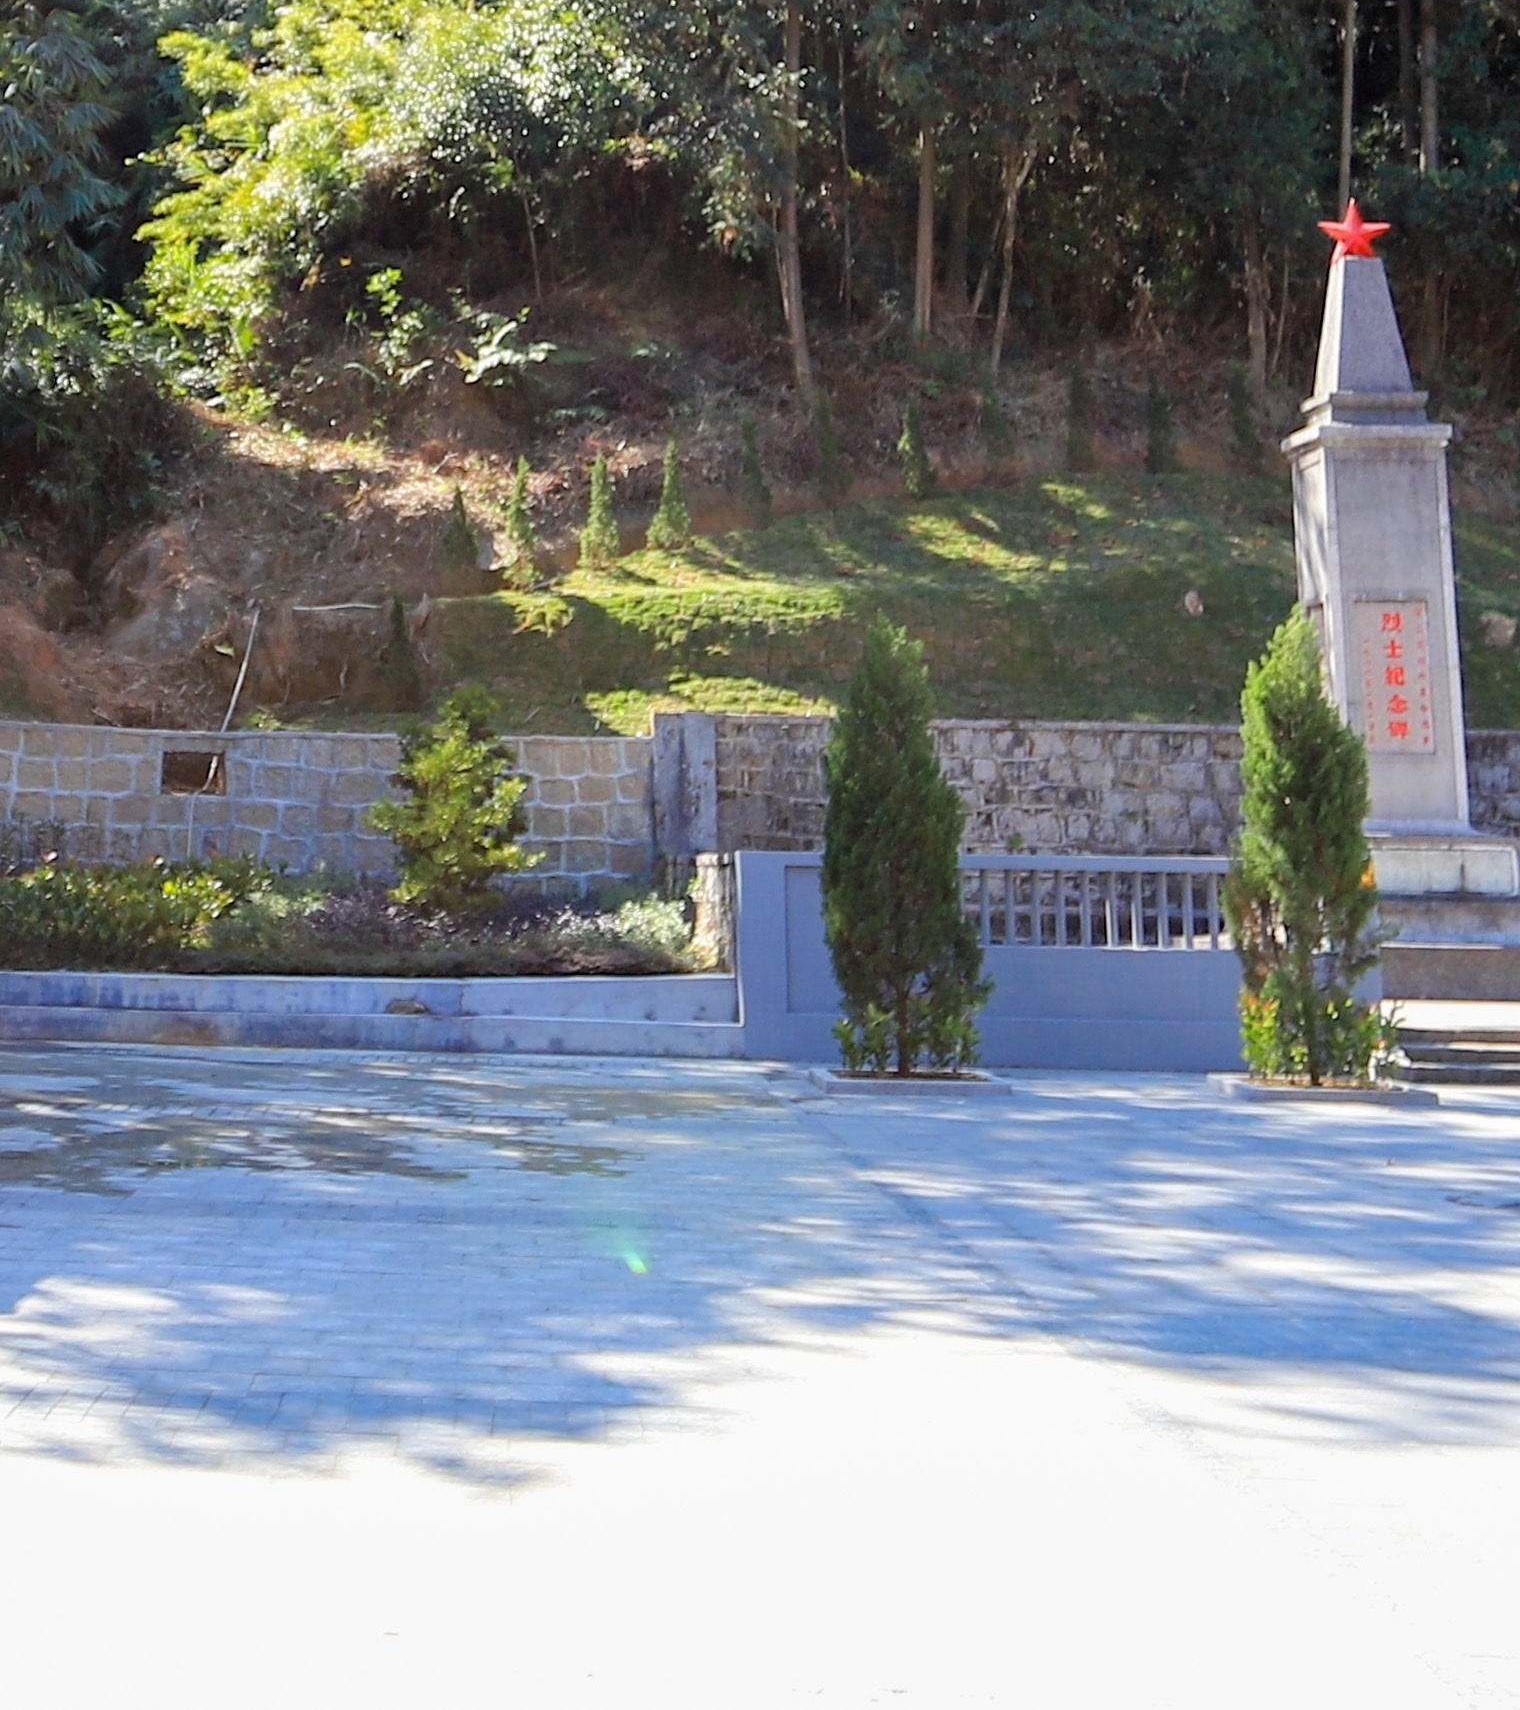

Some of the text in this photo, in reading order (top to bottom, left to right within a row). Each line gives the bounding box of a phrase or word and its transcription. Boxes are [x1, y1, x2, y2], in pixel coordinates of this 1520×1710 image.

[1380, 611, 1410, 739] 烈士纪念碑
